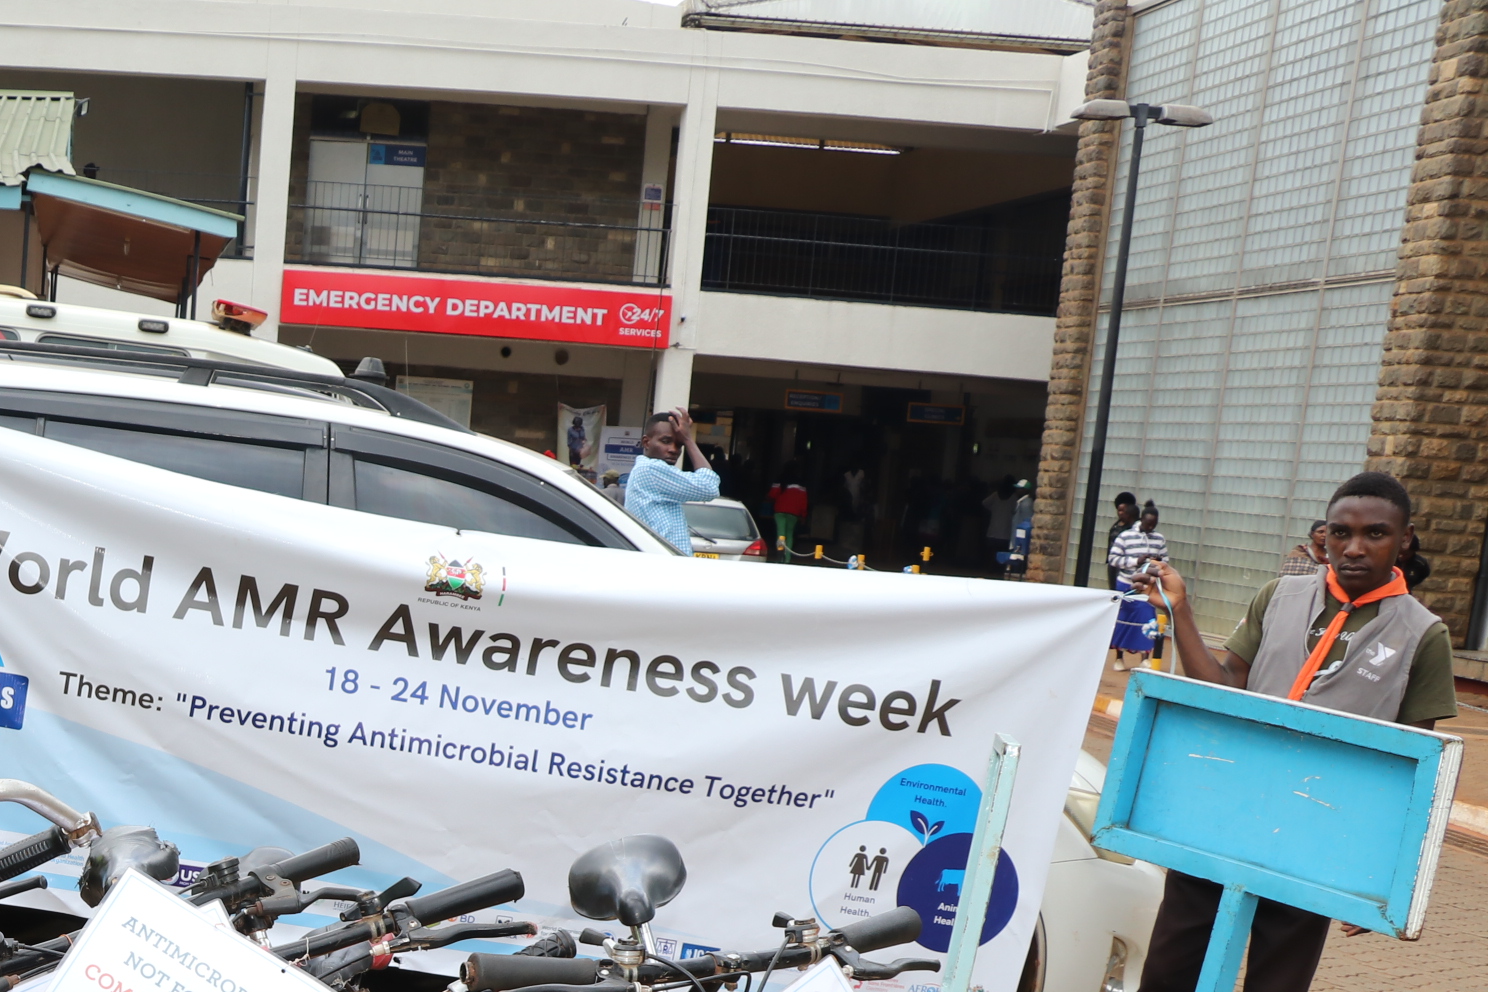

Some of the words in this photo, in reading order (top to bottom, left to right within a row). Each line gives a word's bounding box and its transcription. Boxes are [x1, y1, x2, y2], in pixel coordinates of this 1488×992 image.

[293, 287, 440, 314] EMERGENCY
[446, 298, 608, 326] DEPARTMENT
[631, 306, 665, 323] 24/7
[618, 327, 663, 339] SERVICES
[417, 597, 449, 608] REPUBLIC
[450, 601, 459, 609] OF
[460, 603, 482, 613] KENYA
[172, 566, 350, 647] AMR
[368, 602, 758, 709] Awareness
[779, 672, 962, 738] week
[1356, 667, 1381, 683] STAFF
[324, 666, 359, 695] 18
[391, 676, 430, 706] 24
[439, 684, 594, 732] November
[58, 671, 165, 713] Theme:
[176, 691, 341, 747] "Preventing
[347, 720, 539, 774] Antimicrobial
[548, 751, 695, 797] Resistance
[703, 774, 835, 811] Together"
[900, 777, 967, 797] Environmental
[914, 794, 947, 808] Health.
[49, 857, 84, 867] rganization
[843, 892, 876, 905] Human
[459, 914, 475, 925] BD
[933, 915, 954, 926] Heal
[123, 951, 170, 988] NOT
